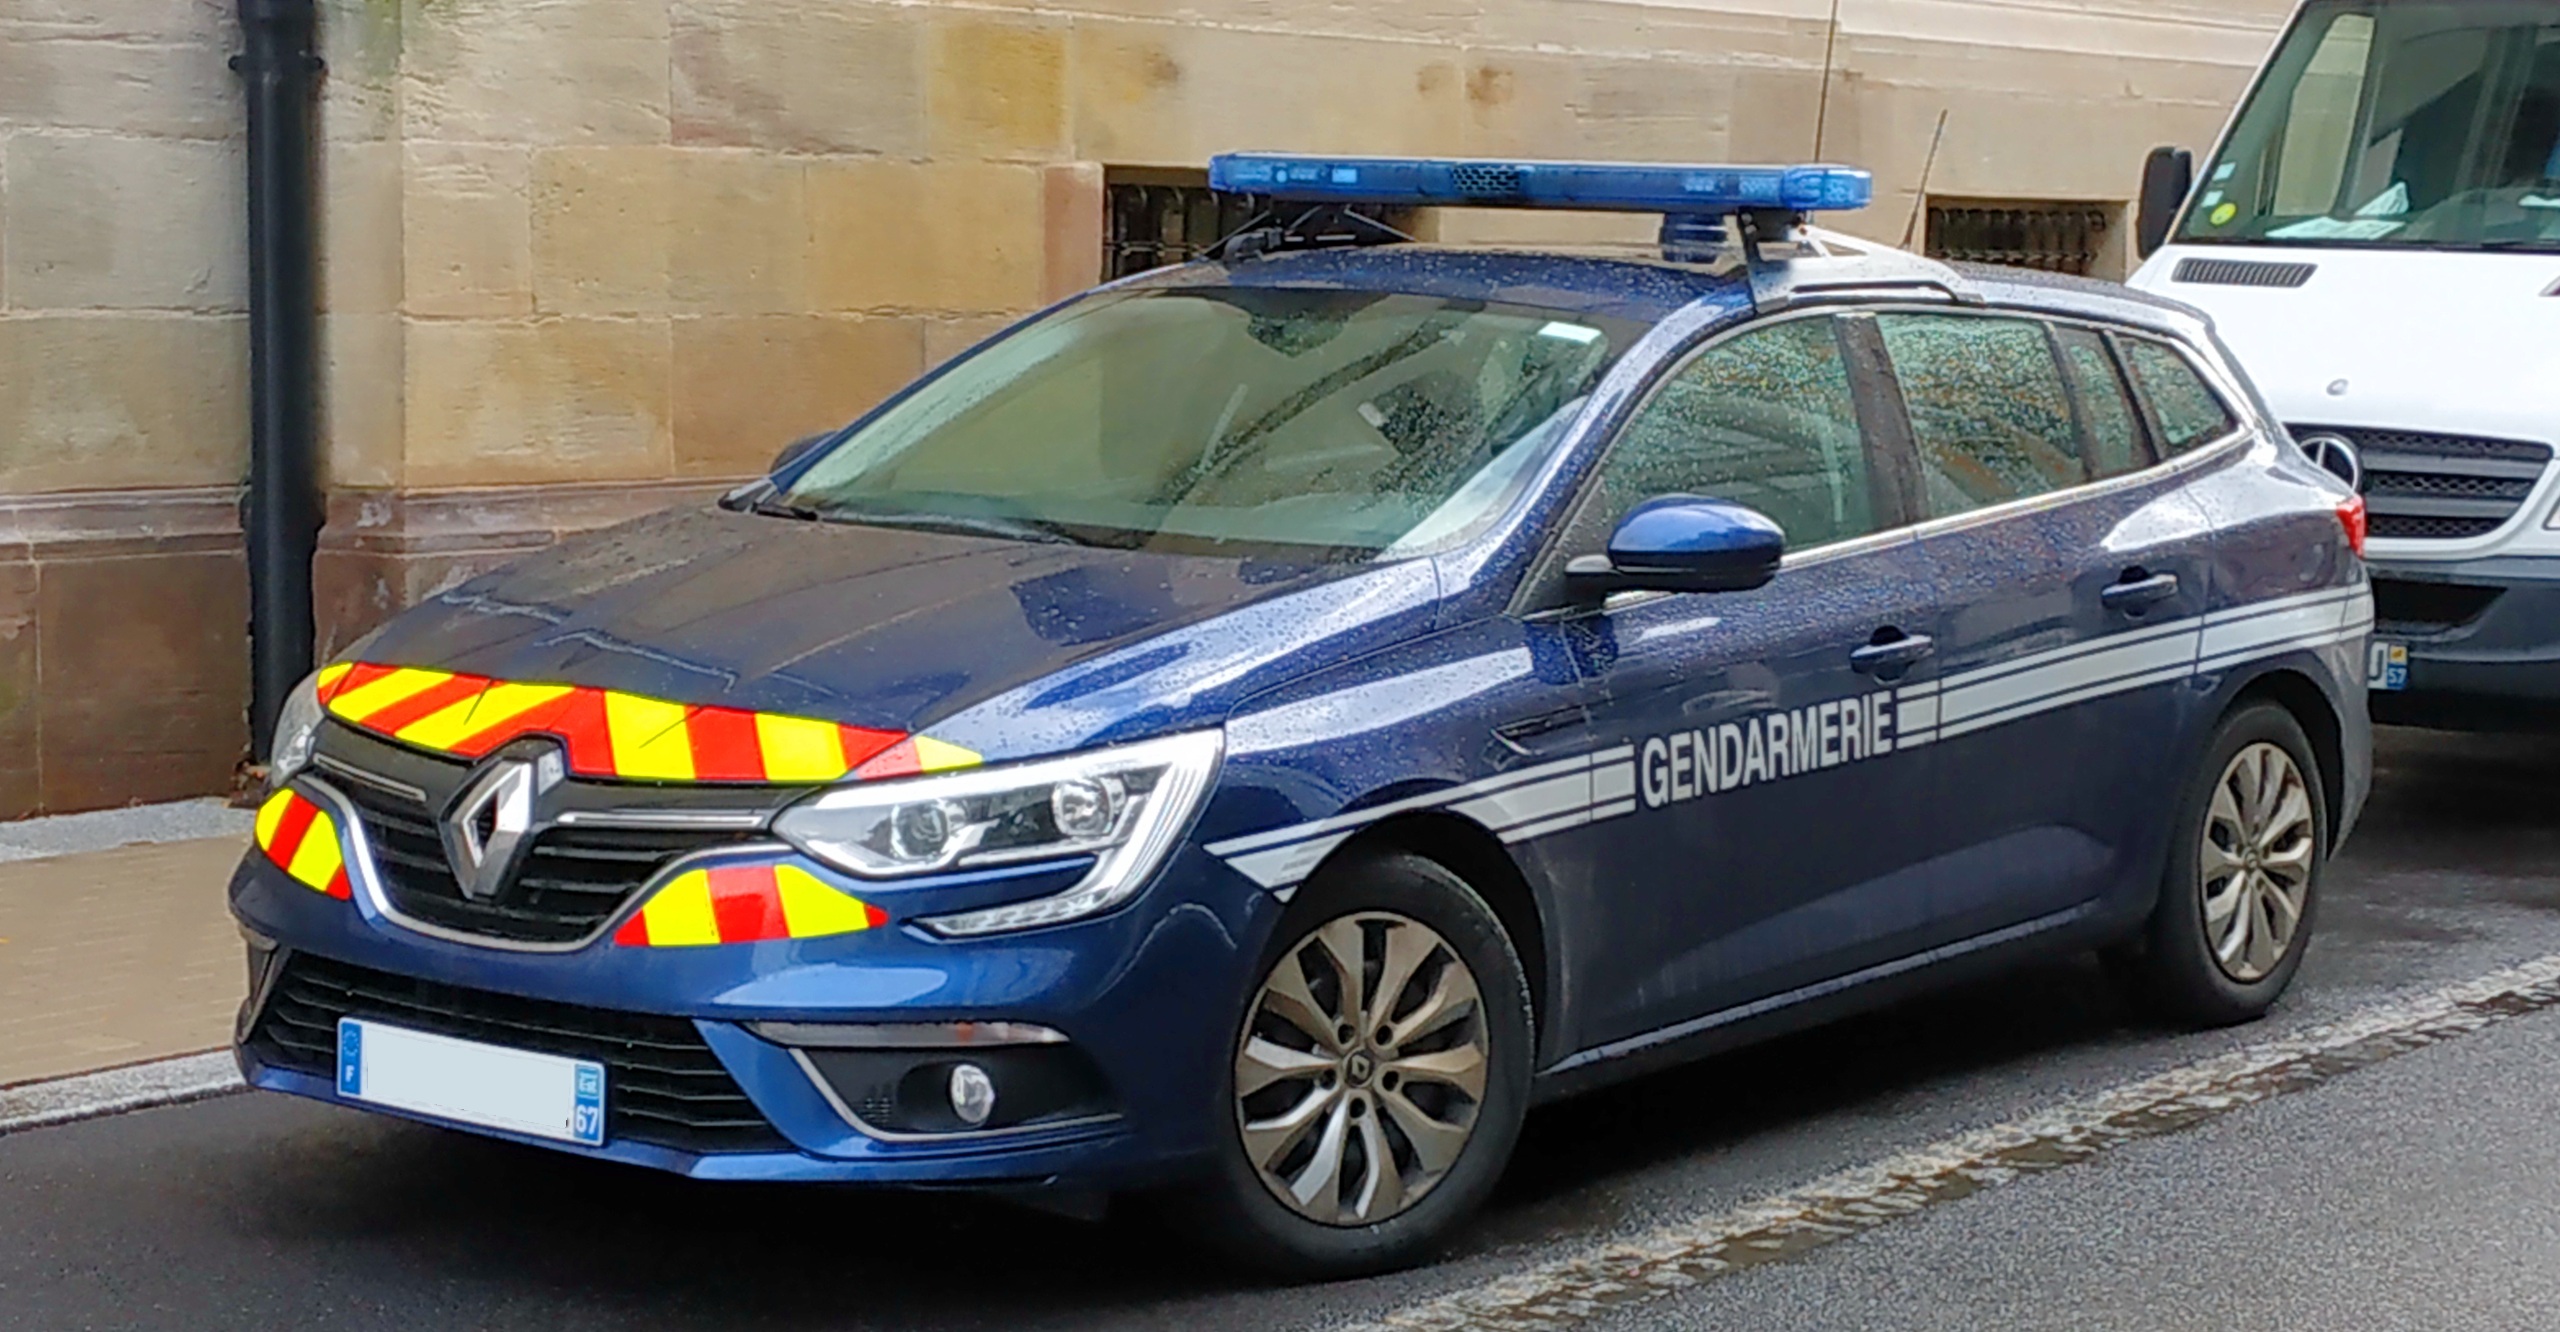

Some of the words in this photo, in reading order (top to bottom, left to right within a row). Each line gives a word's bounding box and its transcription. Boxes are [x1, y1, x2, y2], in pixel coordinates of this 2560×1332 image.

[1642, 690, 1893, 808] GENDARMERIE
[345, 1065, 355, 1082] F
[576, 1104, 599, 1135] 67
